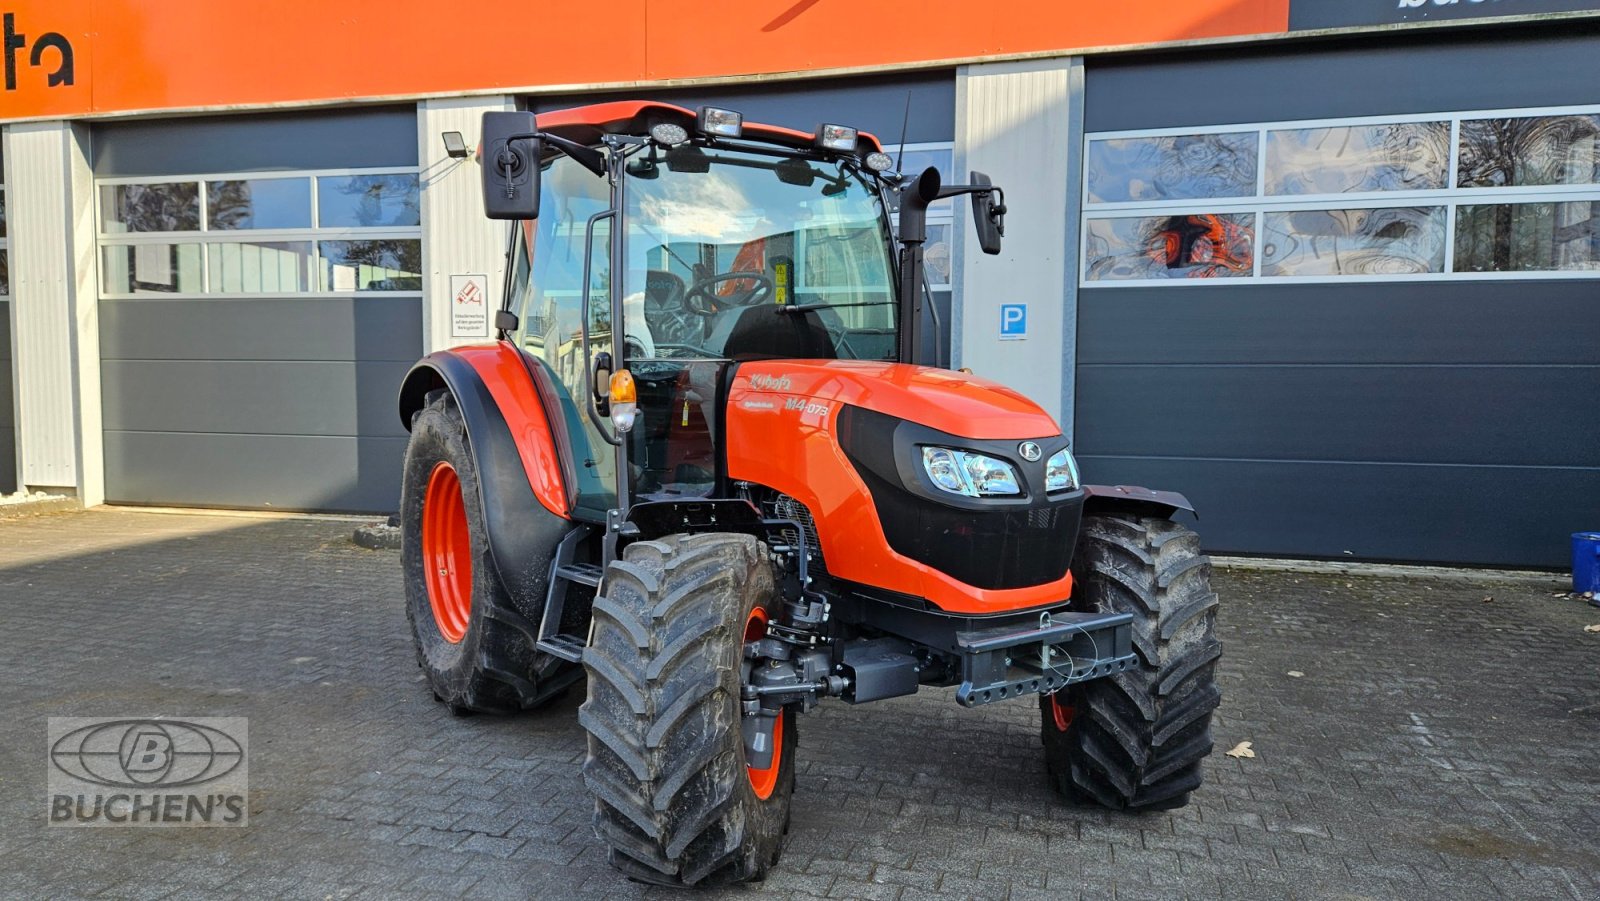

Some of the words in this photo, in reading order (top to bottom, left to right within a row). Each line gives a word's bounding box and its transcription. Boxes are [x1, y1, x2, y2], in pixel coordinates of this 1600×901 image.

[3, 12, 74, 91] ta
[1003, 307, 1023, 331] P
[751, 374, 791, 391] Kubota
[785, 397, 829, 417] M4-073
